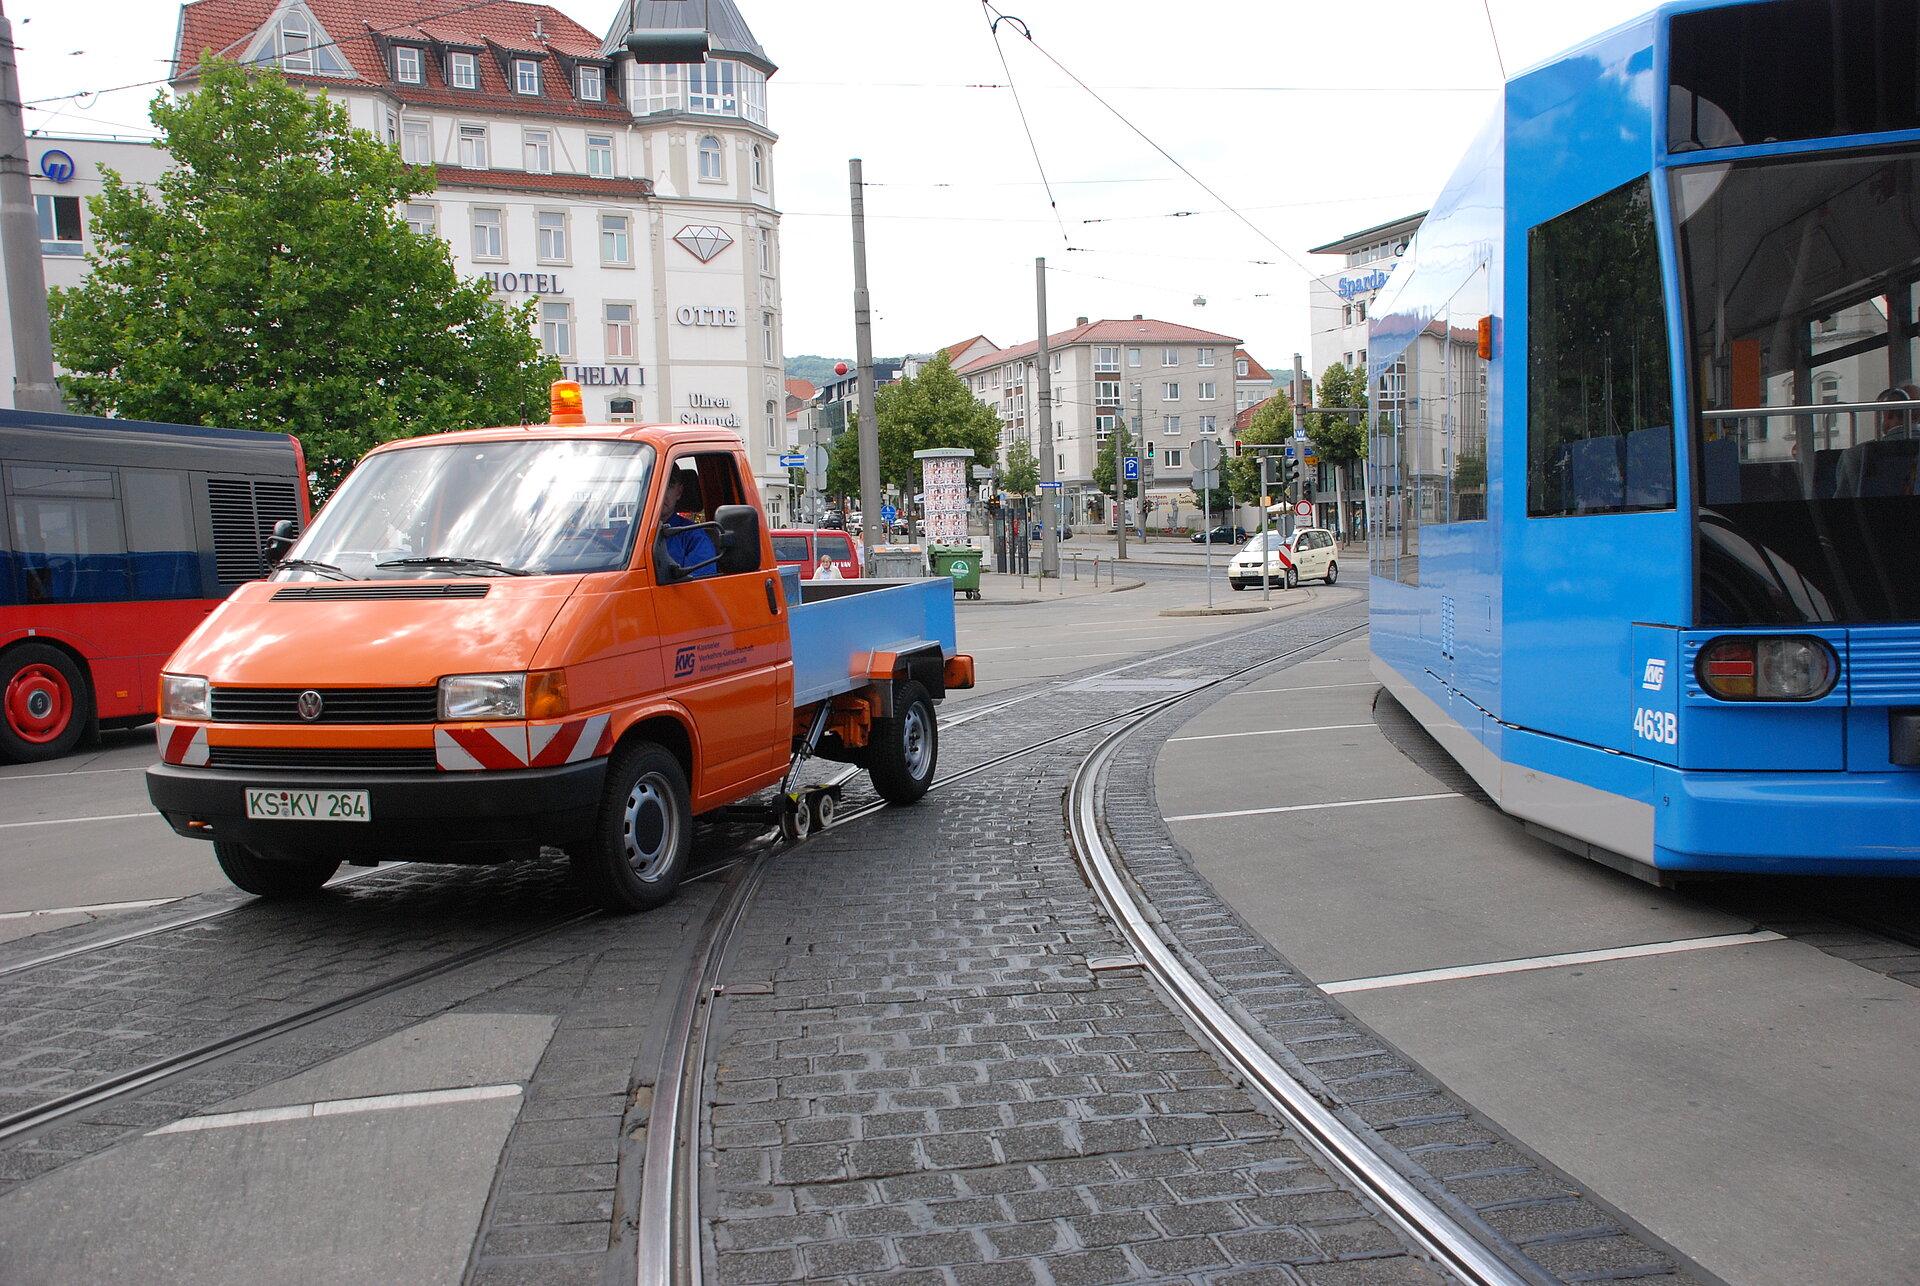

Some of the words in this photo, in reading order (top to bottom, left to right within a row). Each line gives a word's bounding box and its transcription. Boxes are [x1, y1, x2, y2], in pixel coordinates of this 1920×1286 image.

[485, 272, 565, 293] HOTEL
[677, 305, 738, 327] OTTE
[689, 393, 731, 409] Uhren
[681, 413, 741, 428] Schmuck
[1129, 463, 1135, 472] P
[1633, 707, 1678, 745] 463B
[328, 794, 366, 818] 264
